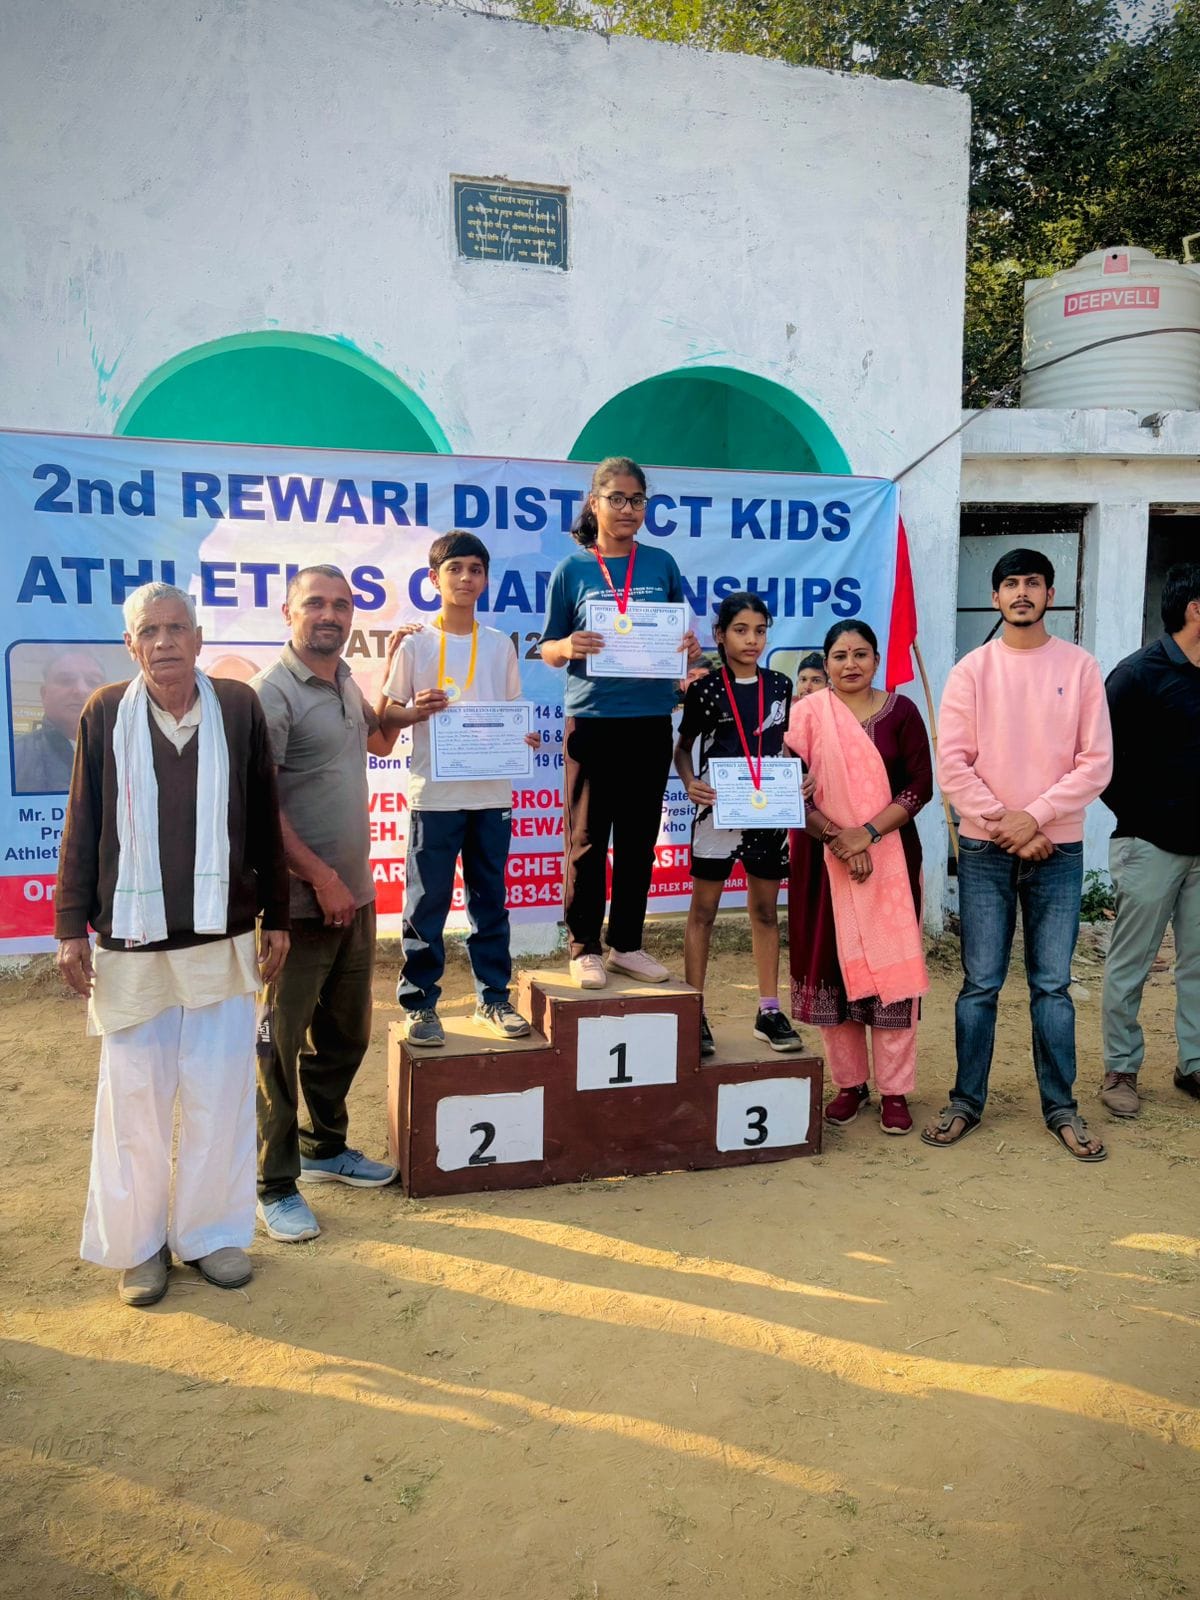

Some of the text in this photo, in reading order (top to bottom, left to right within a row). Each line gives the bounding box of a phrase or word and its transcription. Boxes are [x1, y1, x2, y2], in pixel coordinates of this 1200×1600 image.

[1068, 290, 1154, 312] DEEPVELL
[32, 463, 851, 542] 2nd REWARI DISTCT KIDS
[17, 555, 862, 618] ATHETS CANSHIPS
[535, 705, 550, 719] 14
[368, 756, 401, 770] Born
[535, 754, 550, 767] 19
[19, 808, 45, 822] Mr.
[504, 882, 563, 904] 8343
[659, 882, 681, 893] FLEX
[609, 1042, 633, 1084] 1
[743, 1105, 769, 1146] 3
[468, 1121, 497, 1164] 2
